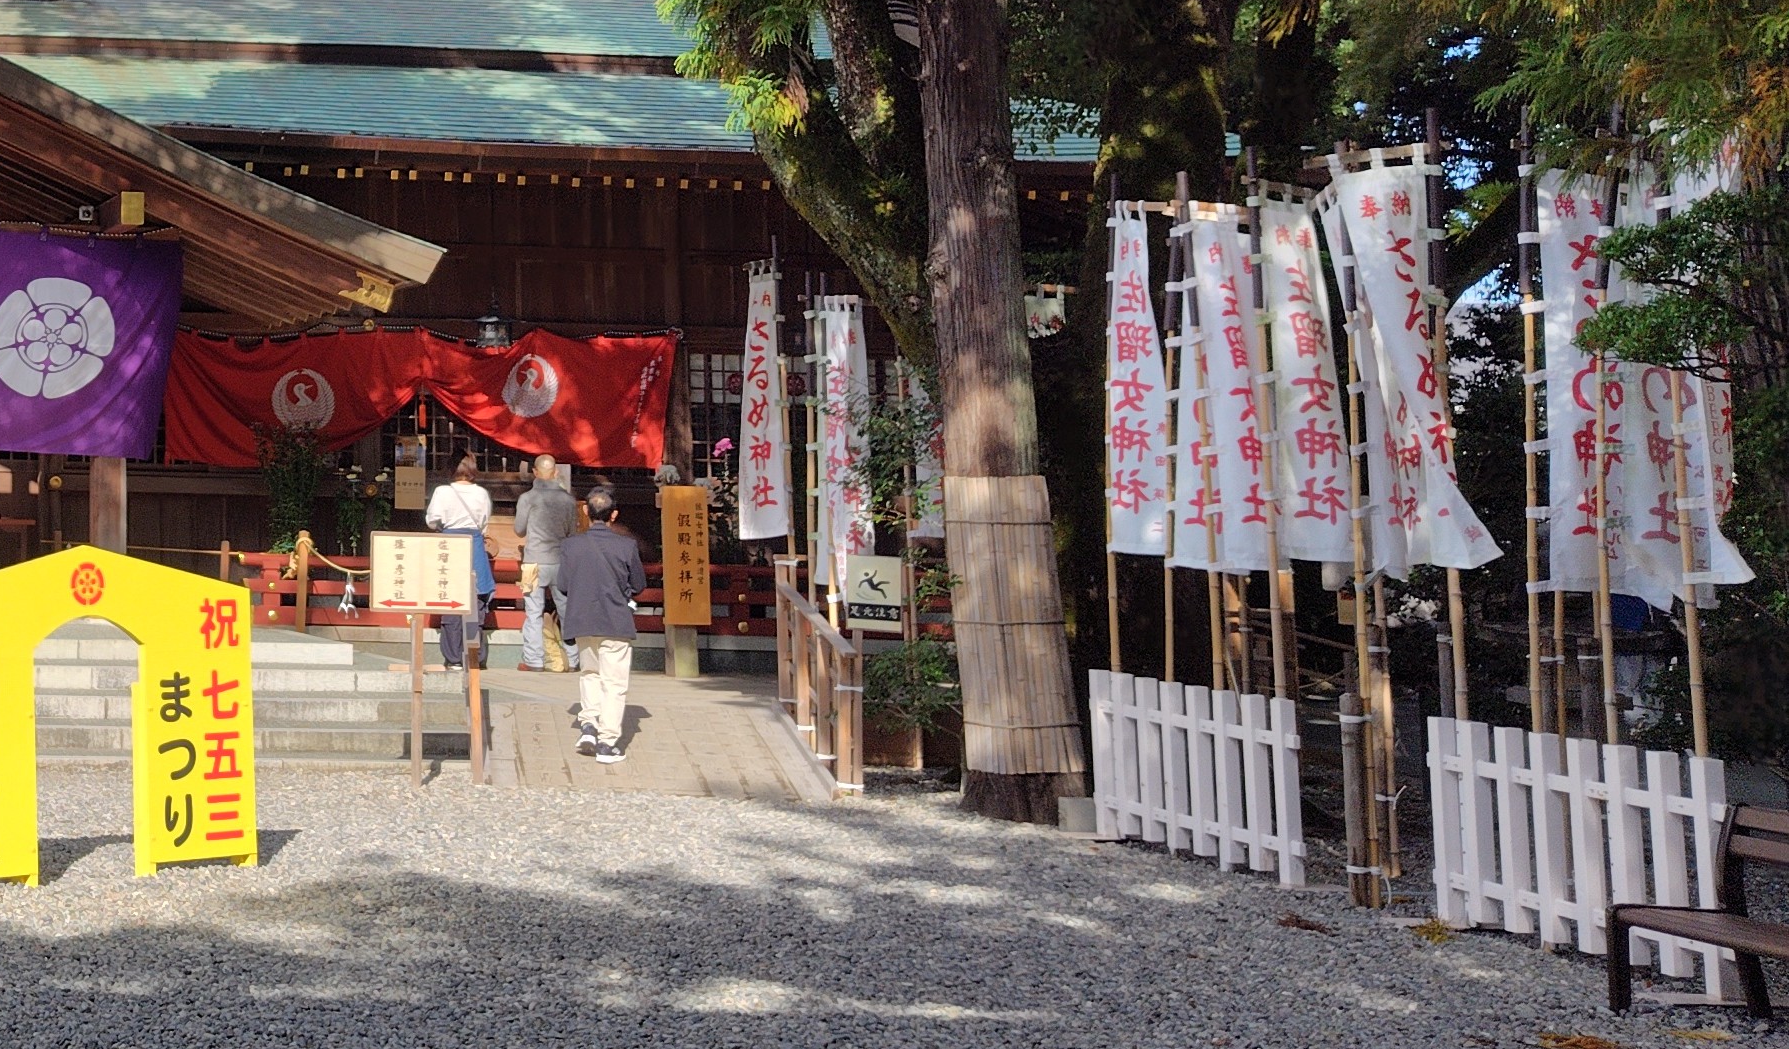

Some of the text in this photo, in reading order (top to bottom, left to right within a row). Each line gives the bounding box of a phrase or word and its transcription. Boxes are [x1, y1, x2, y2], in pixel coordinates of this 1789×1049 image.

[747, 316, 778, 512] さるめ神社
[394, 539, 406, 600] 猿田彦神社
[438, 540, 449, 600] 佐瑠女神社
[158, 671, 197, 848] まつり
[199, 598, 244, 842] 祝 七五三
